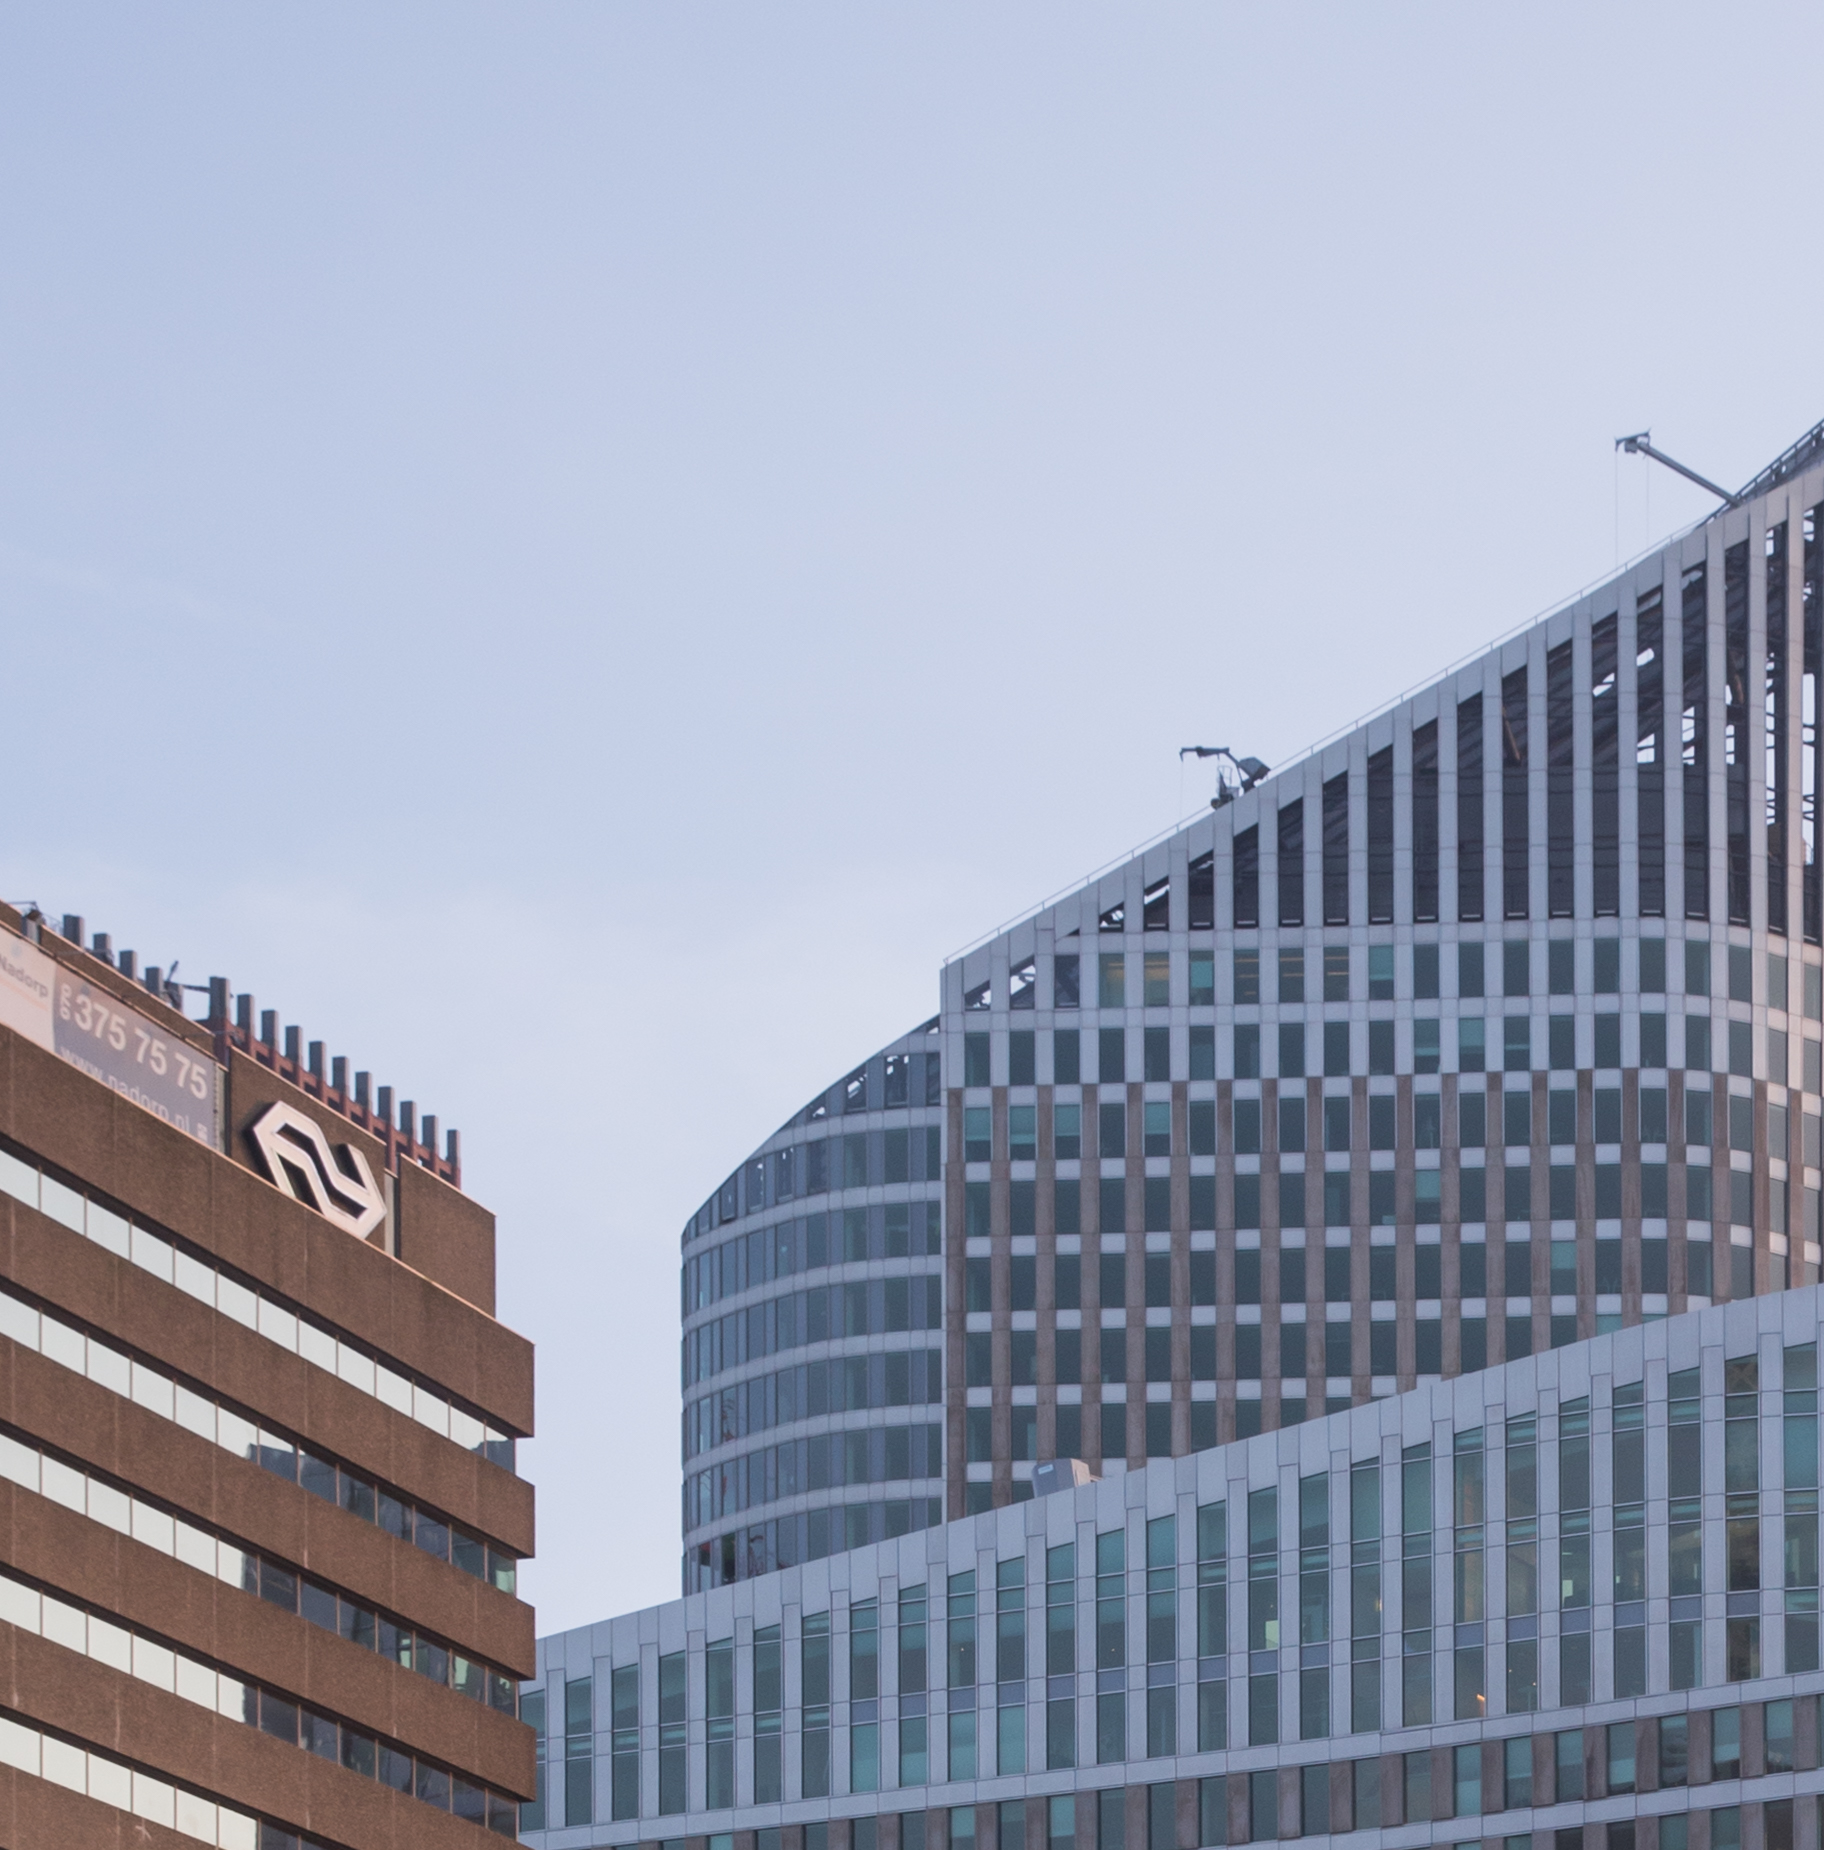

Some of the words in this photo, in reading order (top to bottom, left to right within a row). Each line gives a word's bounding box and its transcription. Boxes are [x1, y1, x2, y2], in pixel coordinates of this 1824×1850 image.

[74, 994, 127, 1051] 375
[134, 1027, 167, 1076] 75
[175, 1052, 208, 1100] 75
